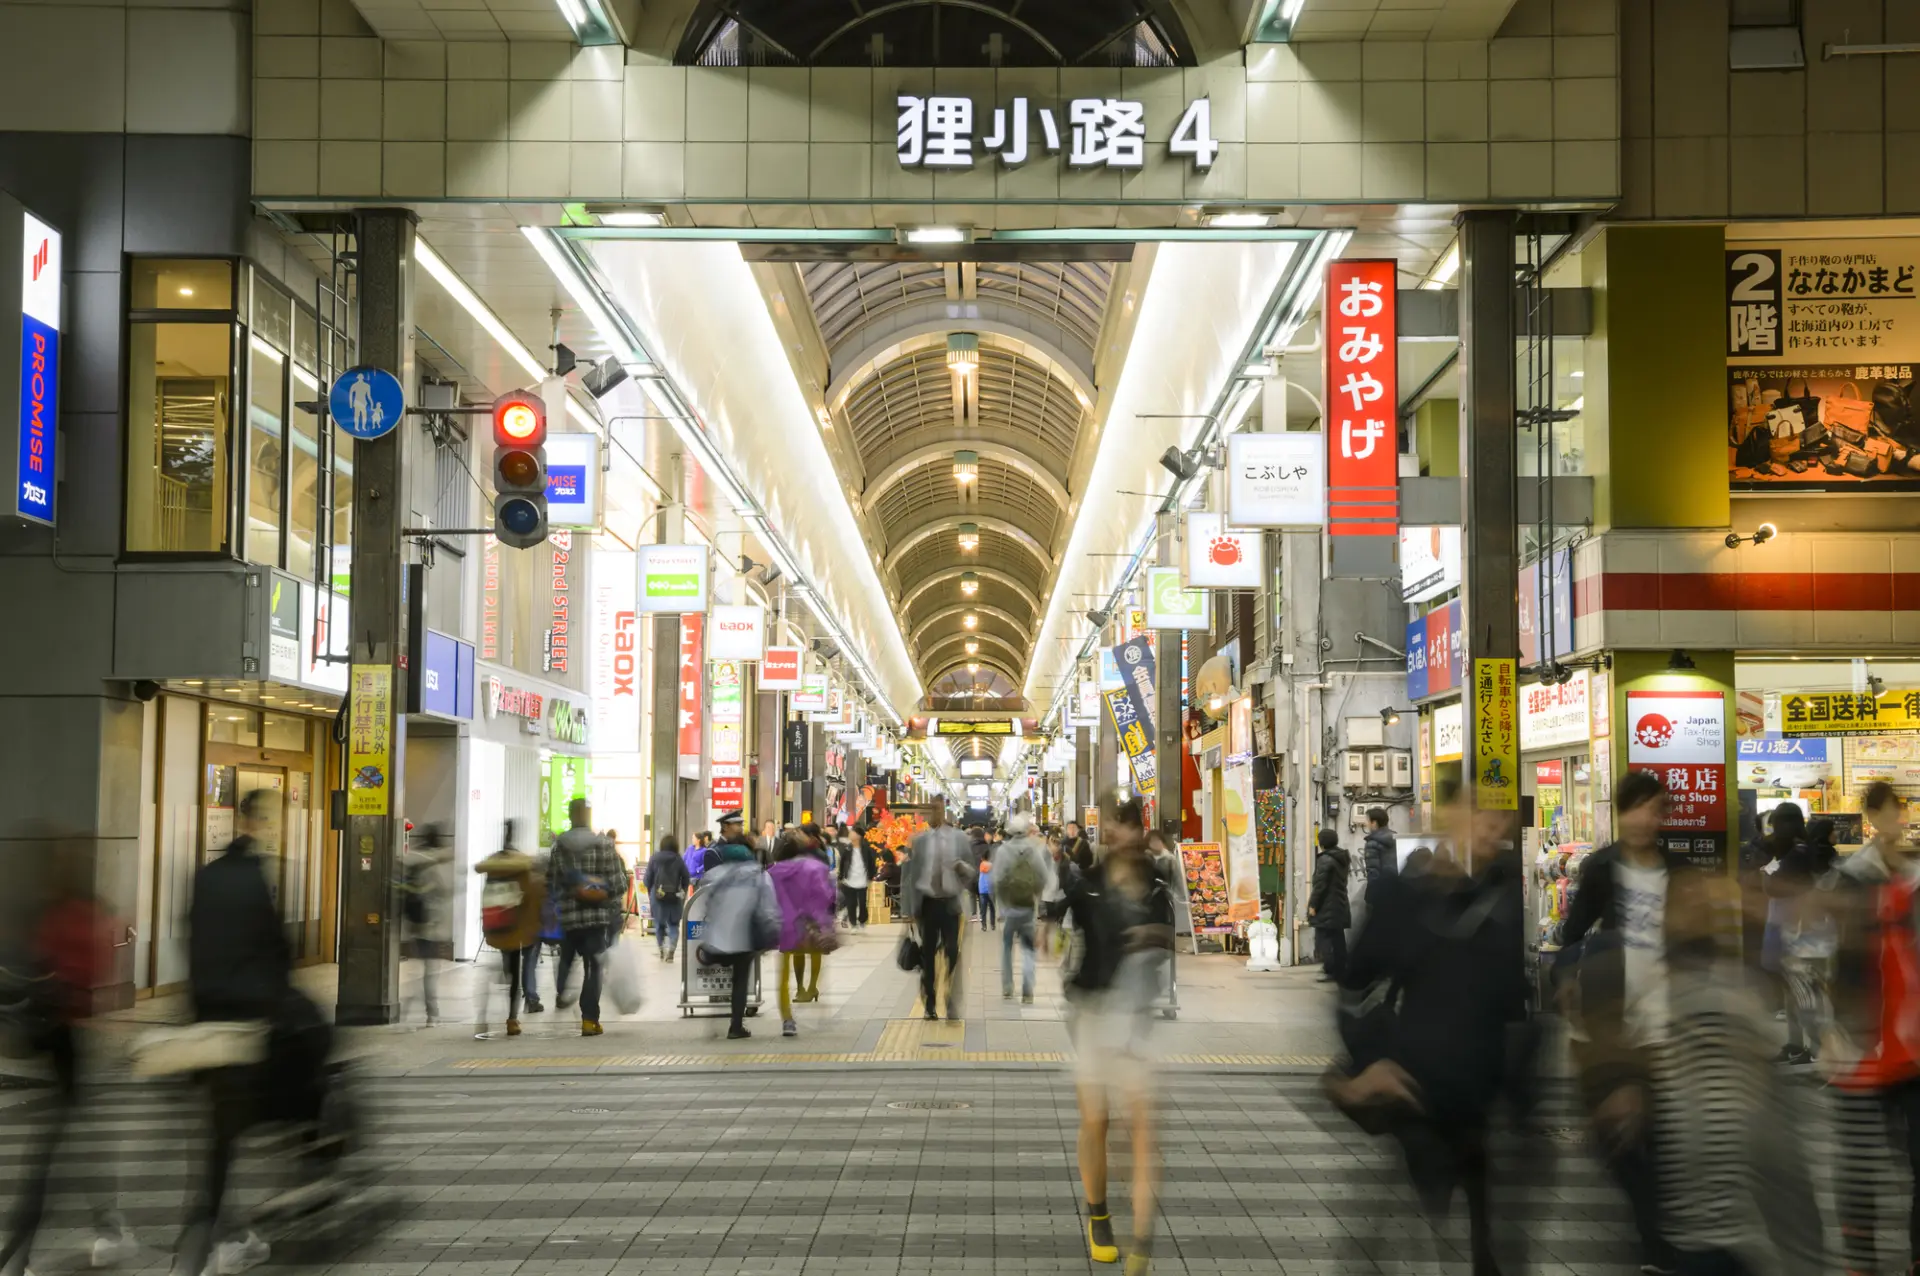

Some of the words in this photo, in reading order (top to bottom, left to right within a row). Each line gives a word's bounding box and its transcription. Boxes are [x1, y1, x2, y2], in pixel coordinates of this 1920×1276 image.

[897, 96, 1145, 166] 狸小路
[1169, 98, 1219, 167] 4
[1787, 265, 1915, 294] ななかまど
[1788, 254, 1877, 266] 手作り鞄の専門店
[1731, 253, 1778, 352] 2階
[1788, 319, 1895, 332] 北海道内の工房で
[1339, 277, 1385, 460] おみやげ
[1855, 366, 1913, 380] 鹿革製品
[29, 332, 46, 474] PROMISE
[1245, 465, 1308, 480] こぶしや
[553, 551, 569, 590] 2nd
[551, 595, 569, 673] STREET
[354, 673, 373, 755] 通行禁止
[373, 673, 387, 755] 許可車両以外
[1480, 663, 1493, 756] ご通行ください
[1498, 663, 1512, 755] 自転車から降りて
[1684, 727, 1721, 737] Tax-free
[1696, 737, 1721, 748] Shop
[1740, 738, 1805, 755] 白い恋人
[1689, 792, 1717, 804] Shop
